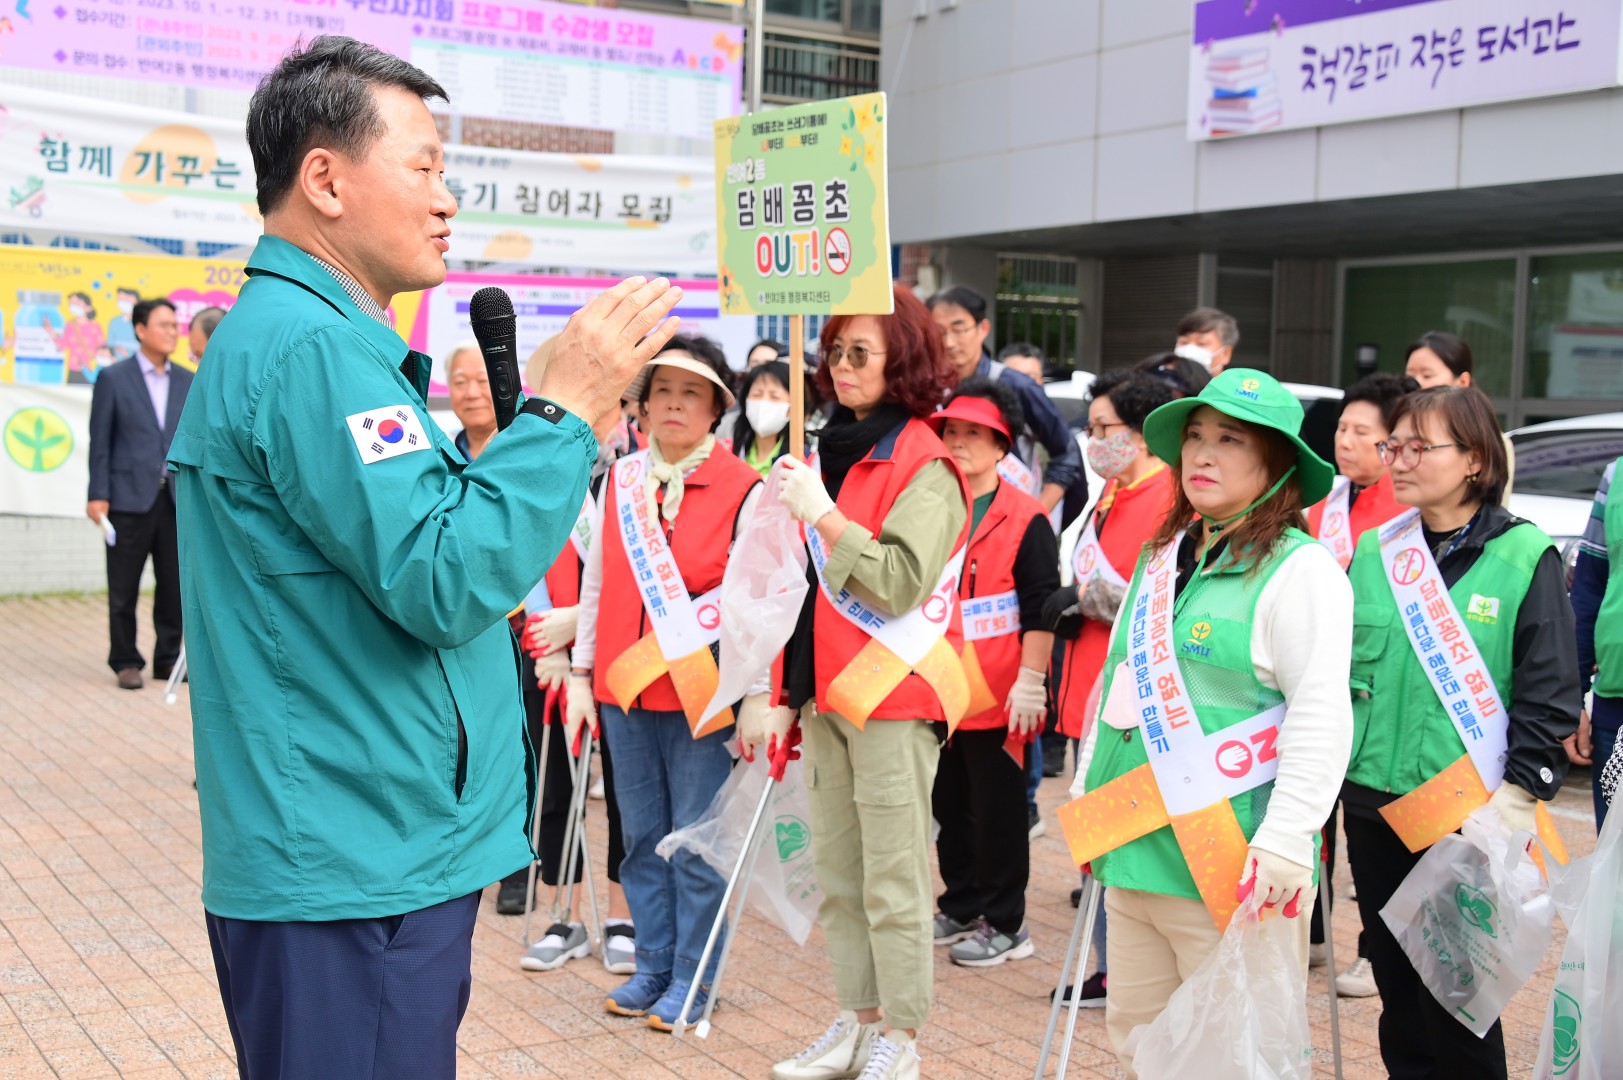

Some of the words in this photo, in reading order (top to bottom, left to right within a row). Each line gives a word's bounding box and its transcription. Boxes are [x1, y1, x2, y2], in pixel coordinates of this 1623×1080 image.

[461, 1, 543, 34] 프로그램
[552, 15, 610, 43] 수강생
[616, 21, 655, 48] 모집
[1301, 43, 1399, 104] 책갈피
[1411, 27, 1465, 89] 작은
[1478, 12, 1581, 63] 도서관
[39, 135, 112, 177] 함께
[134, 150, 241, 189] 가꾸는
[515, 183, 603, 220] 참여자
[617, 192, 672, 222] 모집
[738, 180, 848, 227] 담배꽁초
[756, 229, 820, 276] OUT!
[620, 504, 641, 543] 아름다운
[631, 544, 654, 582] 해운대
[644, 582, 668, 619] 만들기
[655, 562, 684, 601] 없는
[846, 601, 886, 630] 만들기
[1132, 593, 1149, 650] 아름다운
[1151, 569, 1171, 667] 담배꽁초
[1180, 641, 1212, 658] SMU
[1405, 600, 1438, 654] 아름다운
[1427, 655, 1462, 697] 해운대
[1451, 699, 1484, 743] 만들기
[1419, 577, 1474, 666] 담배꽁초
[1463, 668, 1499, 720] 없는
[1133, 651, 1153, 700] 해운대
[1156, 671, 1191, 731] 없는
[1142, 704, 1171, 755] 만들기
